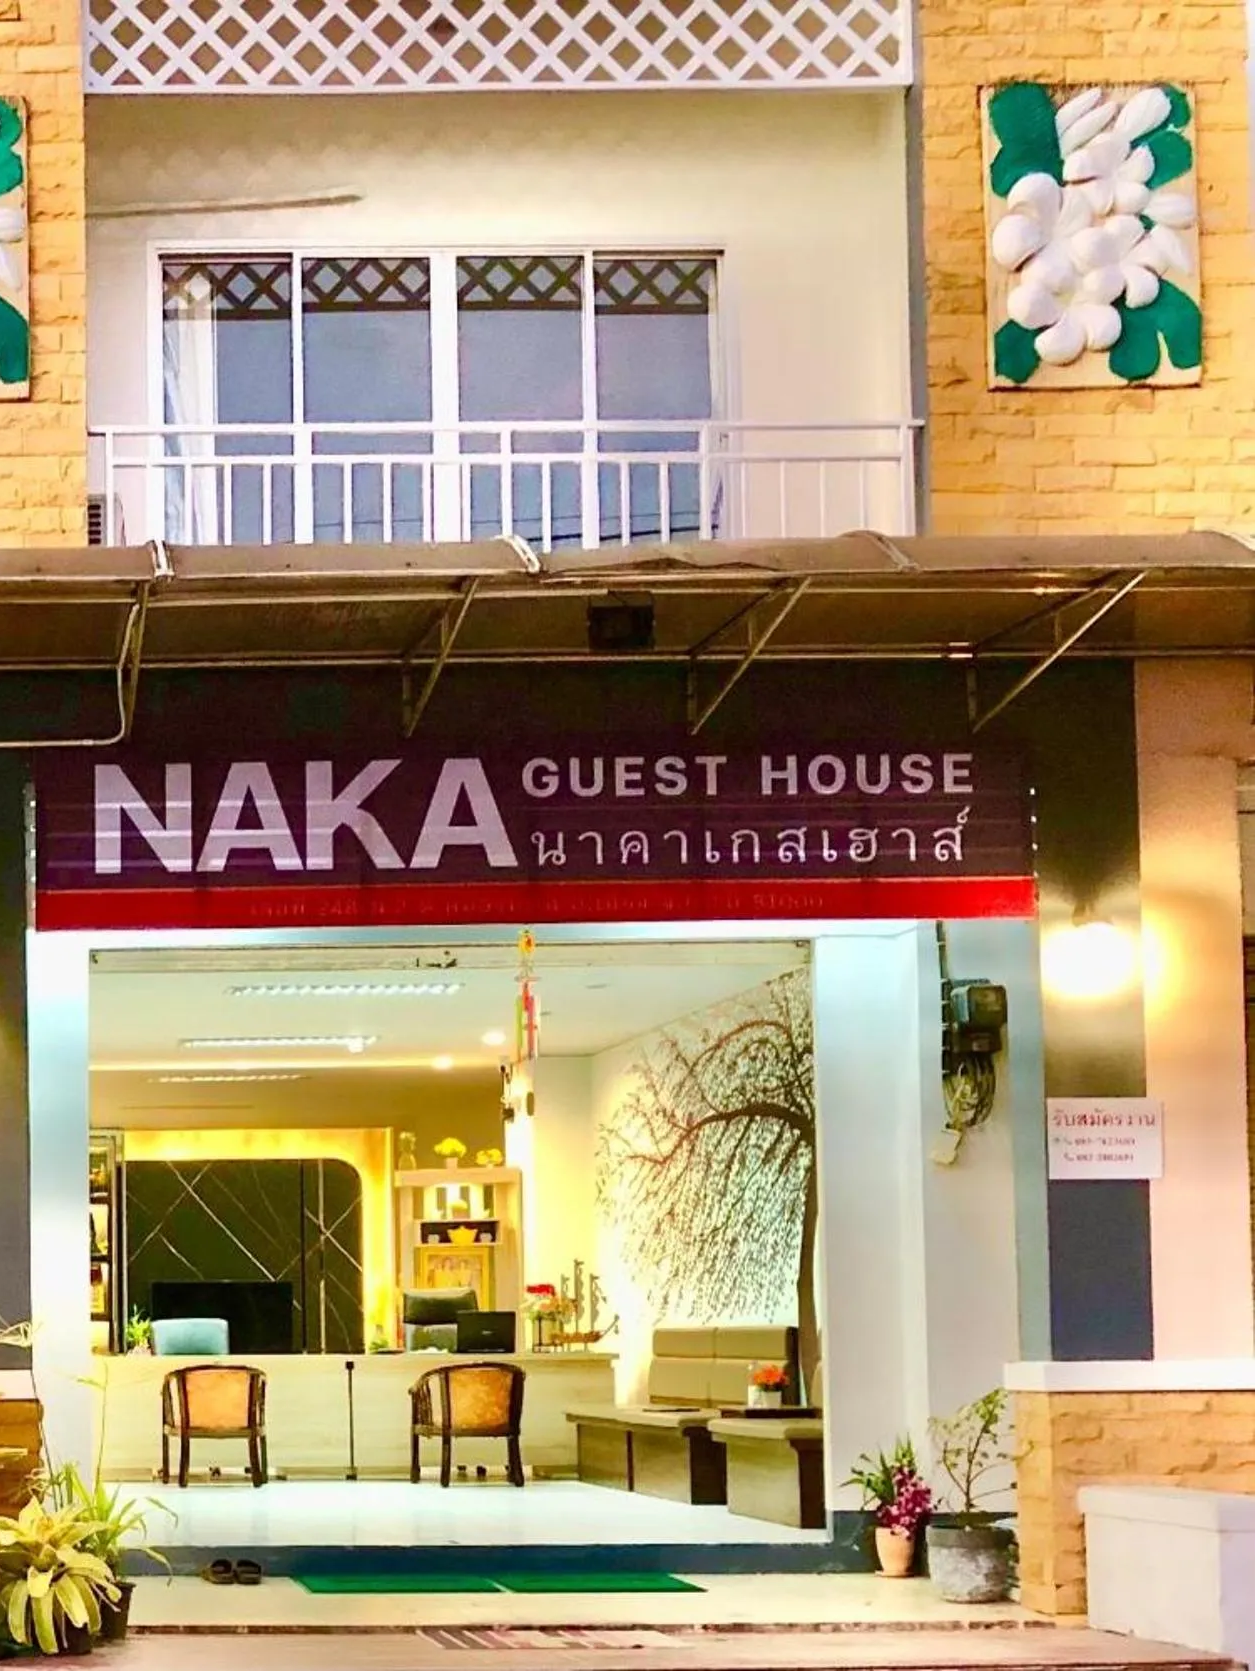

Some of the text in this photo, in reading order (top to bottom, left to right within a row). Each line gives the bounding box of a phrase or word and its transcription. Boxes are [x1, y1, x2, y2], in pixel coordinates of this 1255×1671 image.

[522, 753, 974, 797] GUEST HOUSE
[94, 757, 519, 874] NAKA
[530, 805, 972, 867] นาคาเกสเฮาส์
